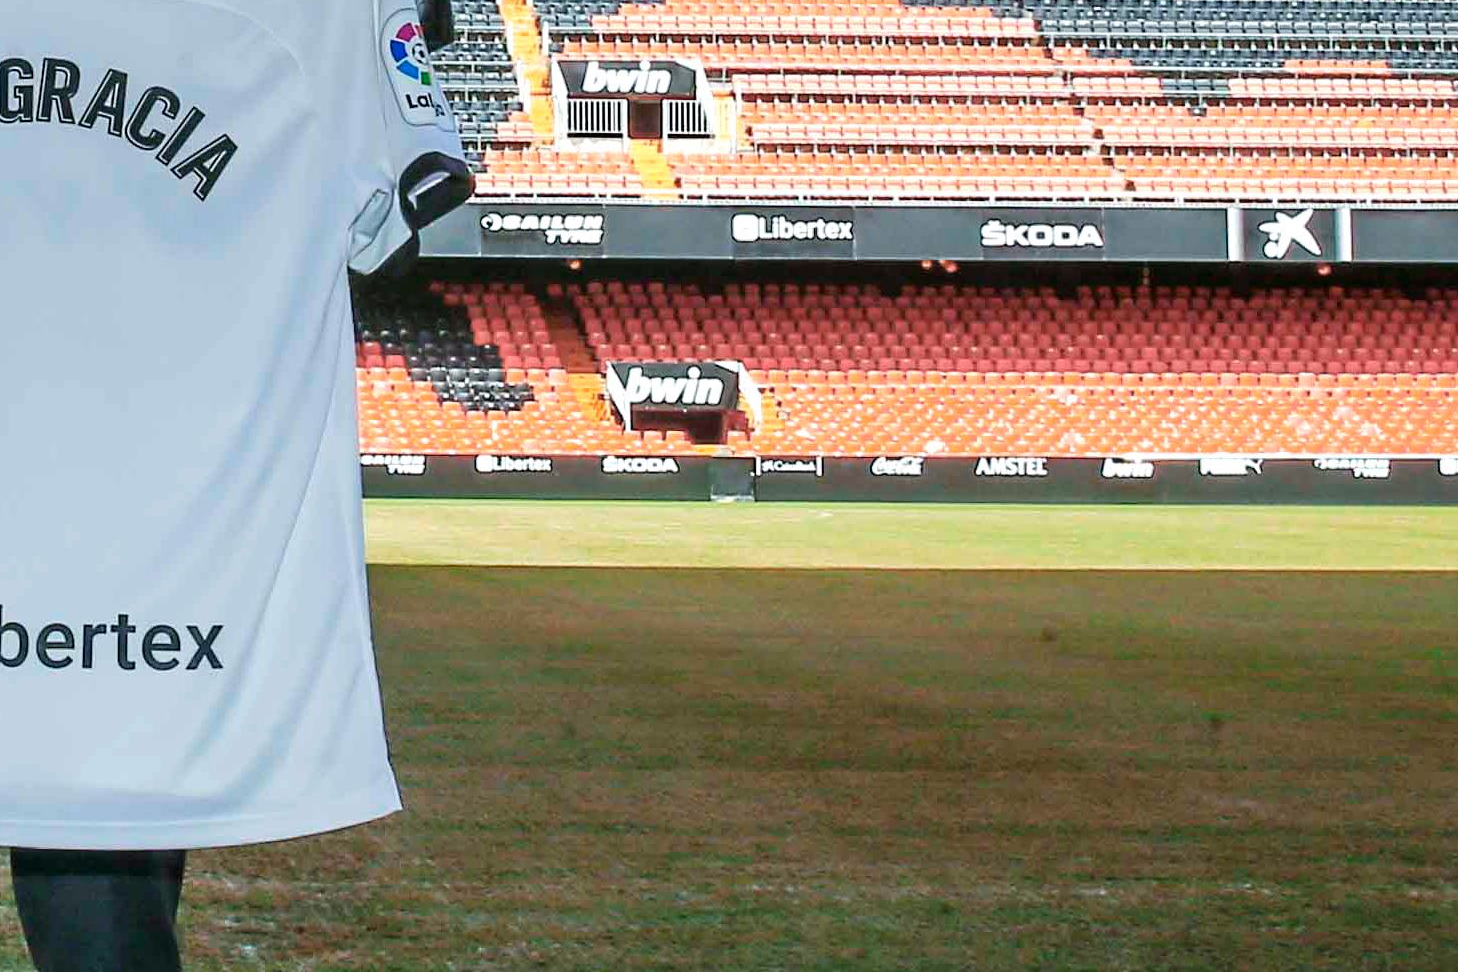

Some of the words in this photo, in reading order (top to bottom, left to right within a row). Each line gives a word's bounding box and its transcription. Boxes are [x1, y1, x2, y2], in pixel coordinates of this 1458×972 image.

[582, 60, 671, 94] bwin
[758, 215, 853, 240] Libertex
[981, 218, 1103, 246] ŠKODA
[626, 365, 723, 405] bwin
[602, 455, 679, 472] ŠKODA
[976, 456, 1048, 476] AMSTEL
